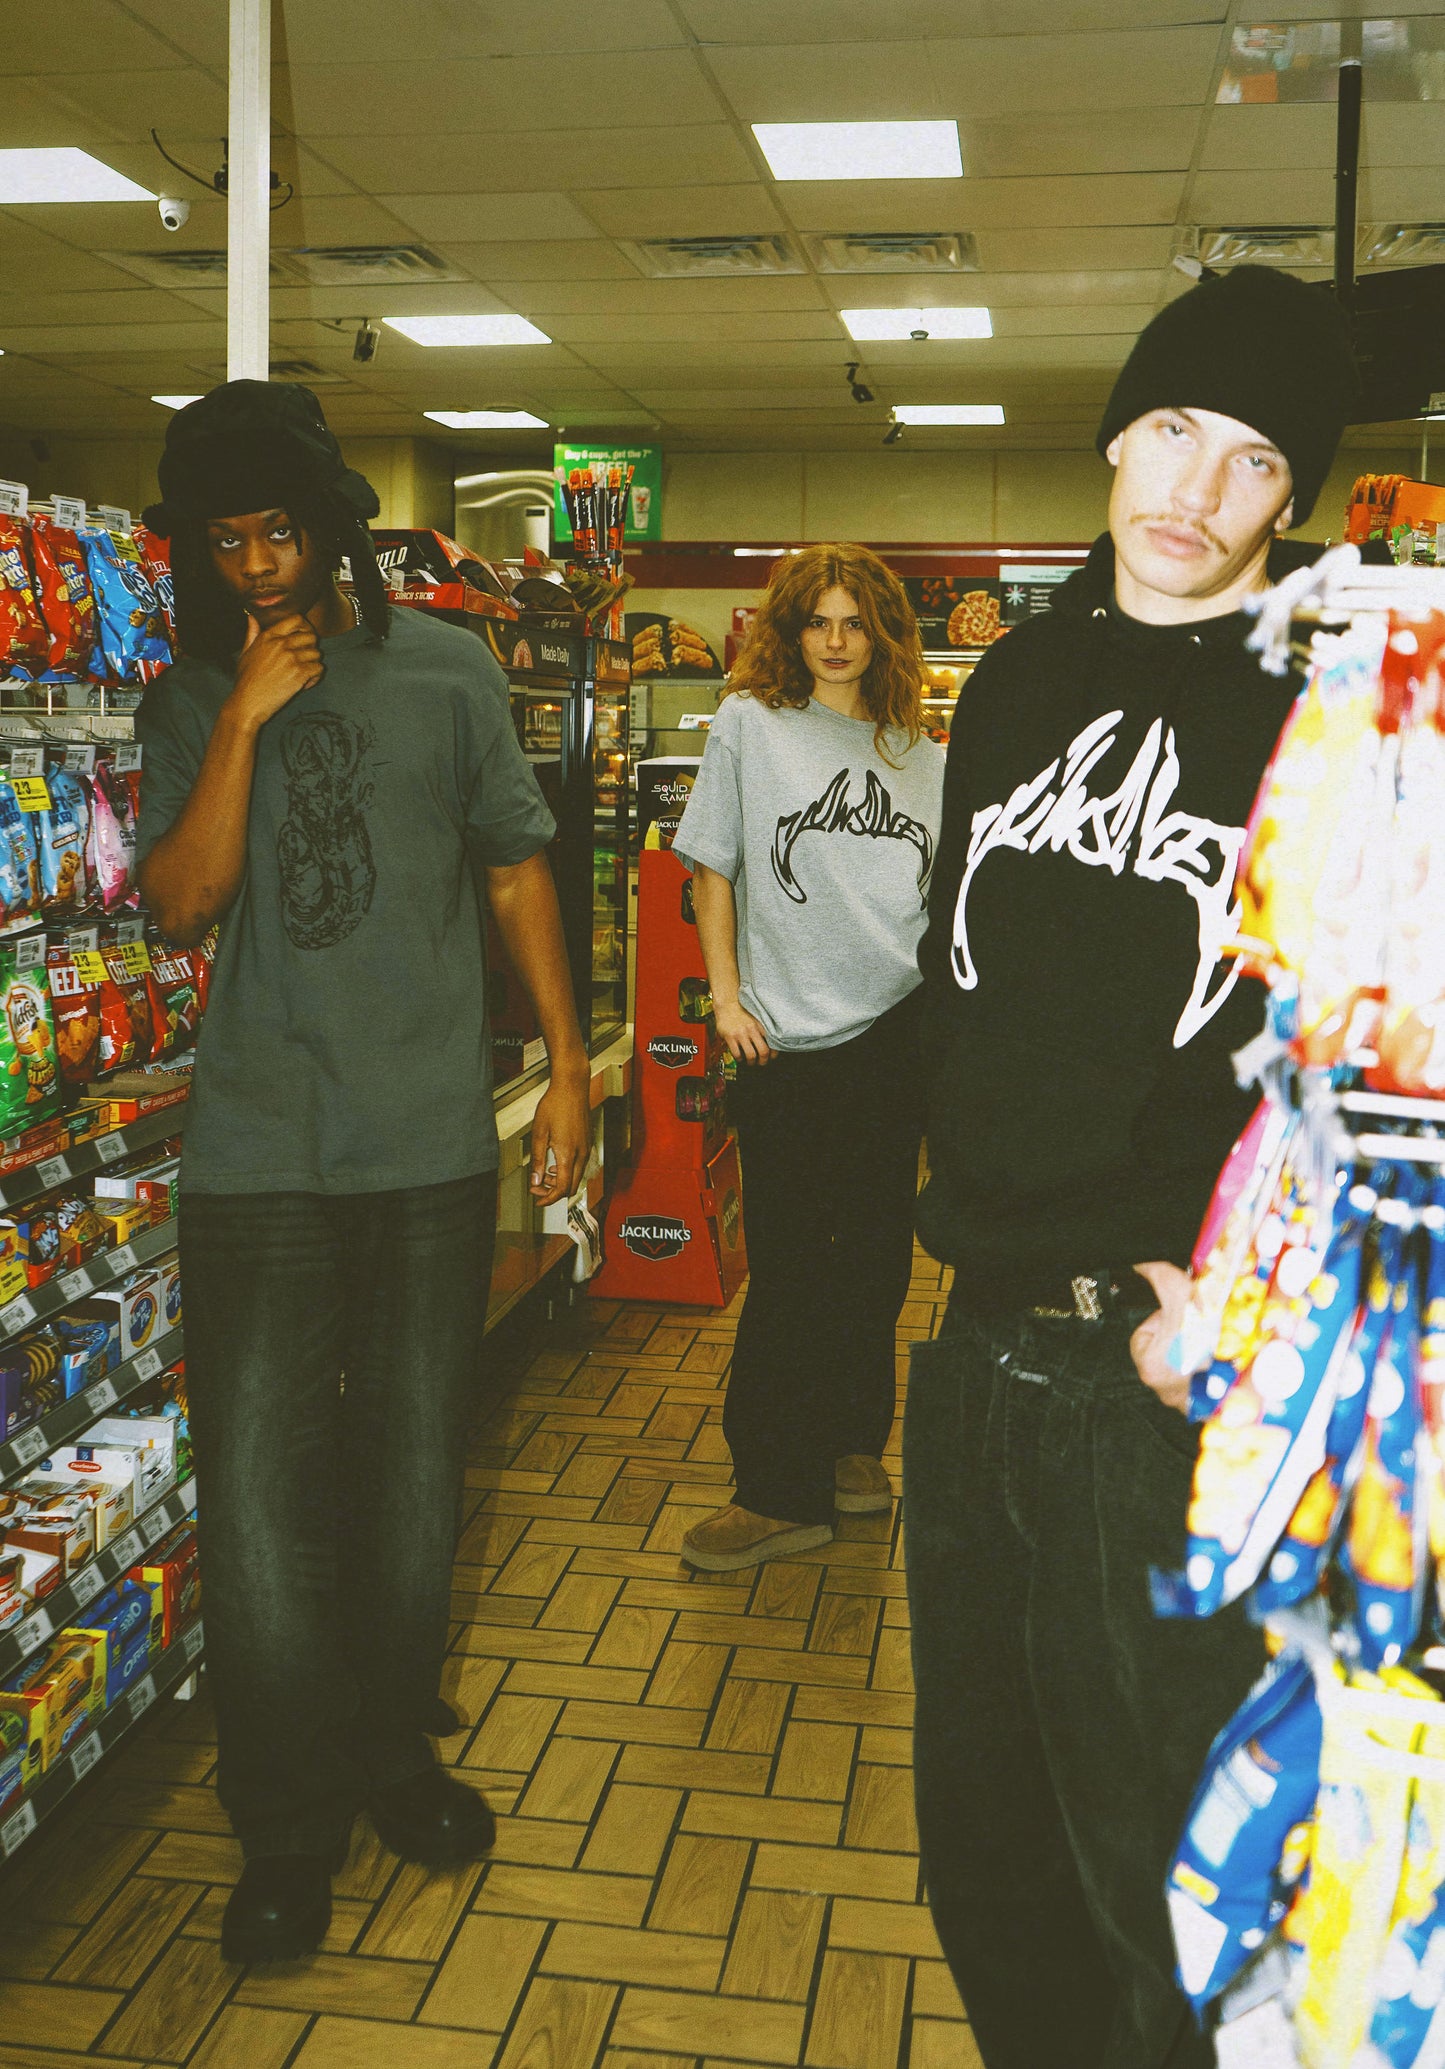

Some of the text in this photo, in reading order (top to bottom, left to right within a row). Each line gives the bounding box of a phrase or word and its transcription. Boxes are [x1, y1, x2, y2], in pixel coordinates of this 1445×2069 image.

[564, 449, 580, 461] Buy
[581, 449, 588, 459] 6
[588, 451, 611, 460] cups,
[612, 450, 626, 460] get
[627, 450, 641, 459] the
[541, 644, 570, 667] Made Daily
[651, 780, 688, 796] SQUID
[659, 793, 691, 805] GAME
[646, 1042, 698, 1055] JACK LINK'S
[618, 1223, 691, 1242] JACK LINK'S
